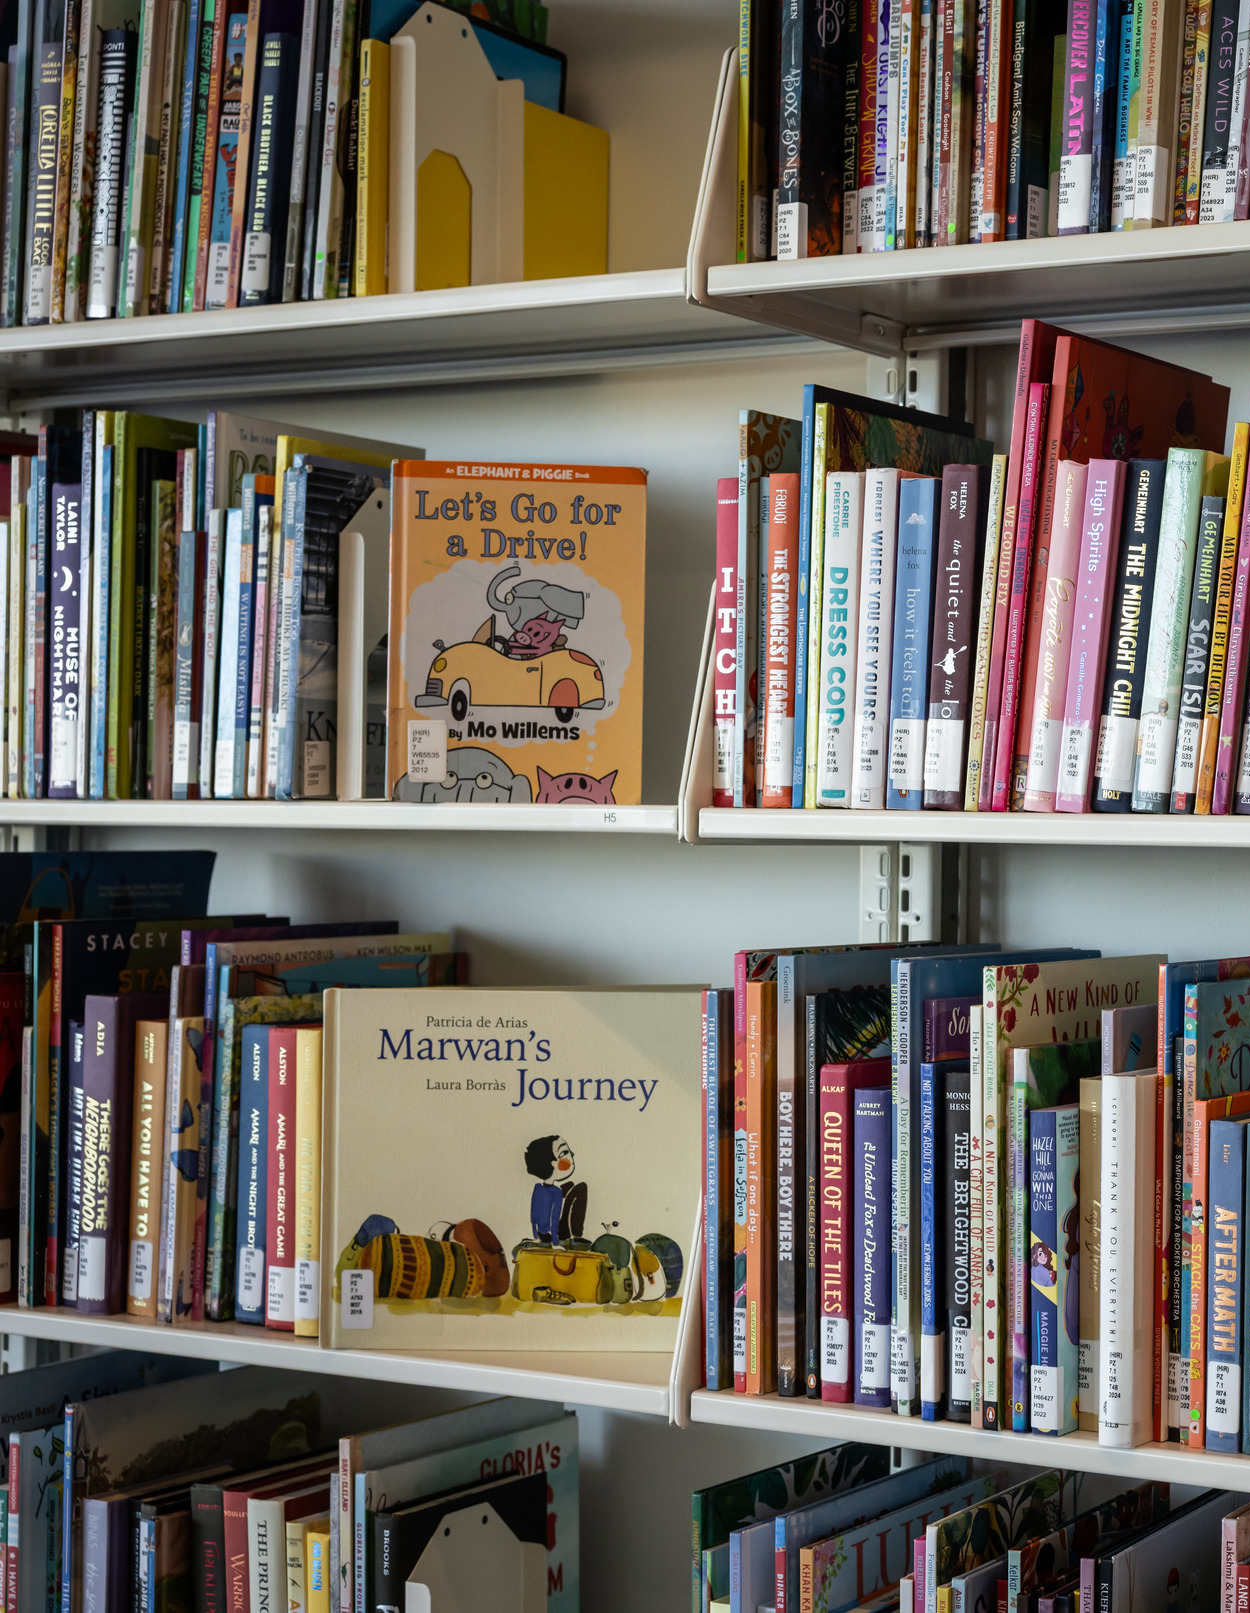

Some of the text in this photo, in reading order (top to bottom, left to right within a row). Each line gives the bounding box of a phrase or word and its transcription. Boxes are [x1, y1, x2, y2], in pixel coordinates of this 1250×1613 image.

[1214, 16, 1234, 132] ACES WILD
[1010, 21, 1025, 184] Biindigen! Amik Says Welcome
[254, 95, 274, 210] BLACK BROTHER, BLACK
[359, 92, 368, 182] exclamation mark
[456, 466, 521, 478] ELEPHANT
[522, 469, 531, 478] &
[532, 468, 573, 480] PIGGIE
[415, 490, 622, 526] Let's Go for
[841, 491, 849, 529] CARRIE
[950, 491, 958, 510] FOX
[959, 481, 968, 520] HELENA
[56, 496, 66, 551] TAYLOR
[67, 502, 78, 544] LAINI
[1088, 478, 1108, 572] High Spirits
[446, 529, 588, 561] a Drive!
[902, 546, 927, 555] helena
[907, 561, 921, 570] fox
[828, 567, 849, 658] DRESS
[1116, 542, 1147, 674] THE MIDNIGHT
[65, 628, 78, 721] MUSE OF
[449, 722, 580, 740] By Mo Willems
[1102, 790, 1121, 800] HOLT
[604, 813, 617, 823] H5
[86, 931, 169, 952] STACEY
[232, 949, 335, 966] RAYMOND ANTROBUS
[426, 1016, 528, 1028] Patricia de Arias
[252, 1042, 260, 1081] ALSTON
[377, 1028, 552, 1062] Marwan's
[279, 1047, 287, 1085] ALSTON
[426, 1078, 506, 1091] Laura Borràs
[511, 1068, 659, 1112] Journey
[821, 1086, 845, 1094] ALKAF
[1032, 1137, 1053, 1151] HAZEL
[1035, 1150, 1051, 1166] HILL
[1033, 1180, 1053, 1193] WIN
[824, 1111, 842, 1313] QUEEN OF THE TILES
[1033, 1200, 1053, 1211] ONE
[257, 1520, 268, 1557] THE
[802, 1563, 811, 1594] KHAN
[1010, 1564, 1018, 1592] Kelkar
[1225, 1541, 1234, 1582] Lakshmi
